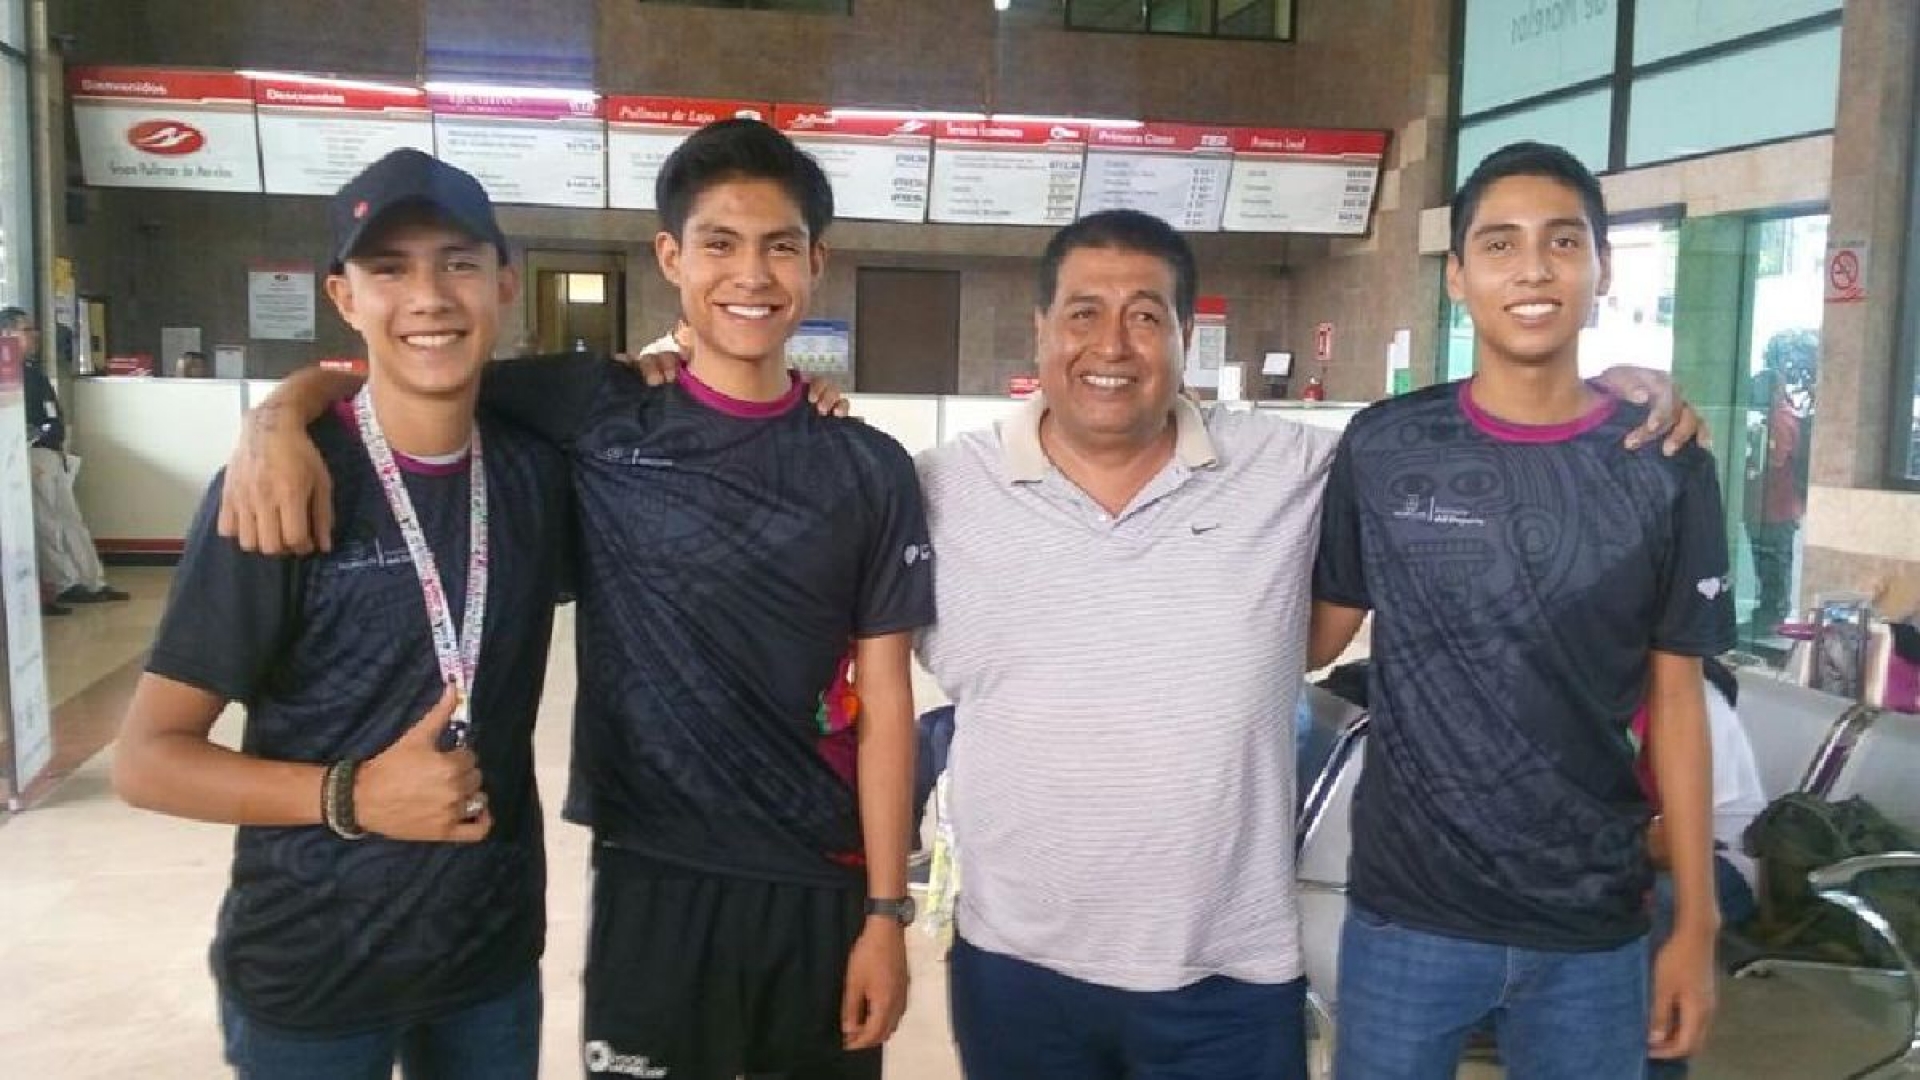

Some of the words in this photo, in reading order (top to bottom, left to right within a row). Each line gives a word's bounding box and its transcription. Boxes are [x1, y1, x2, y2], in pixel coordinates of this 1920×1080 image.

[81, 79, 168, 96] Bienvenidos
[265, 88, 346, 105] Descuentos
[618, 105, 668, 121] Pullman
[671, 109, 687, 122] de
[1098, 130, 1144, 146] Primera
